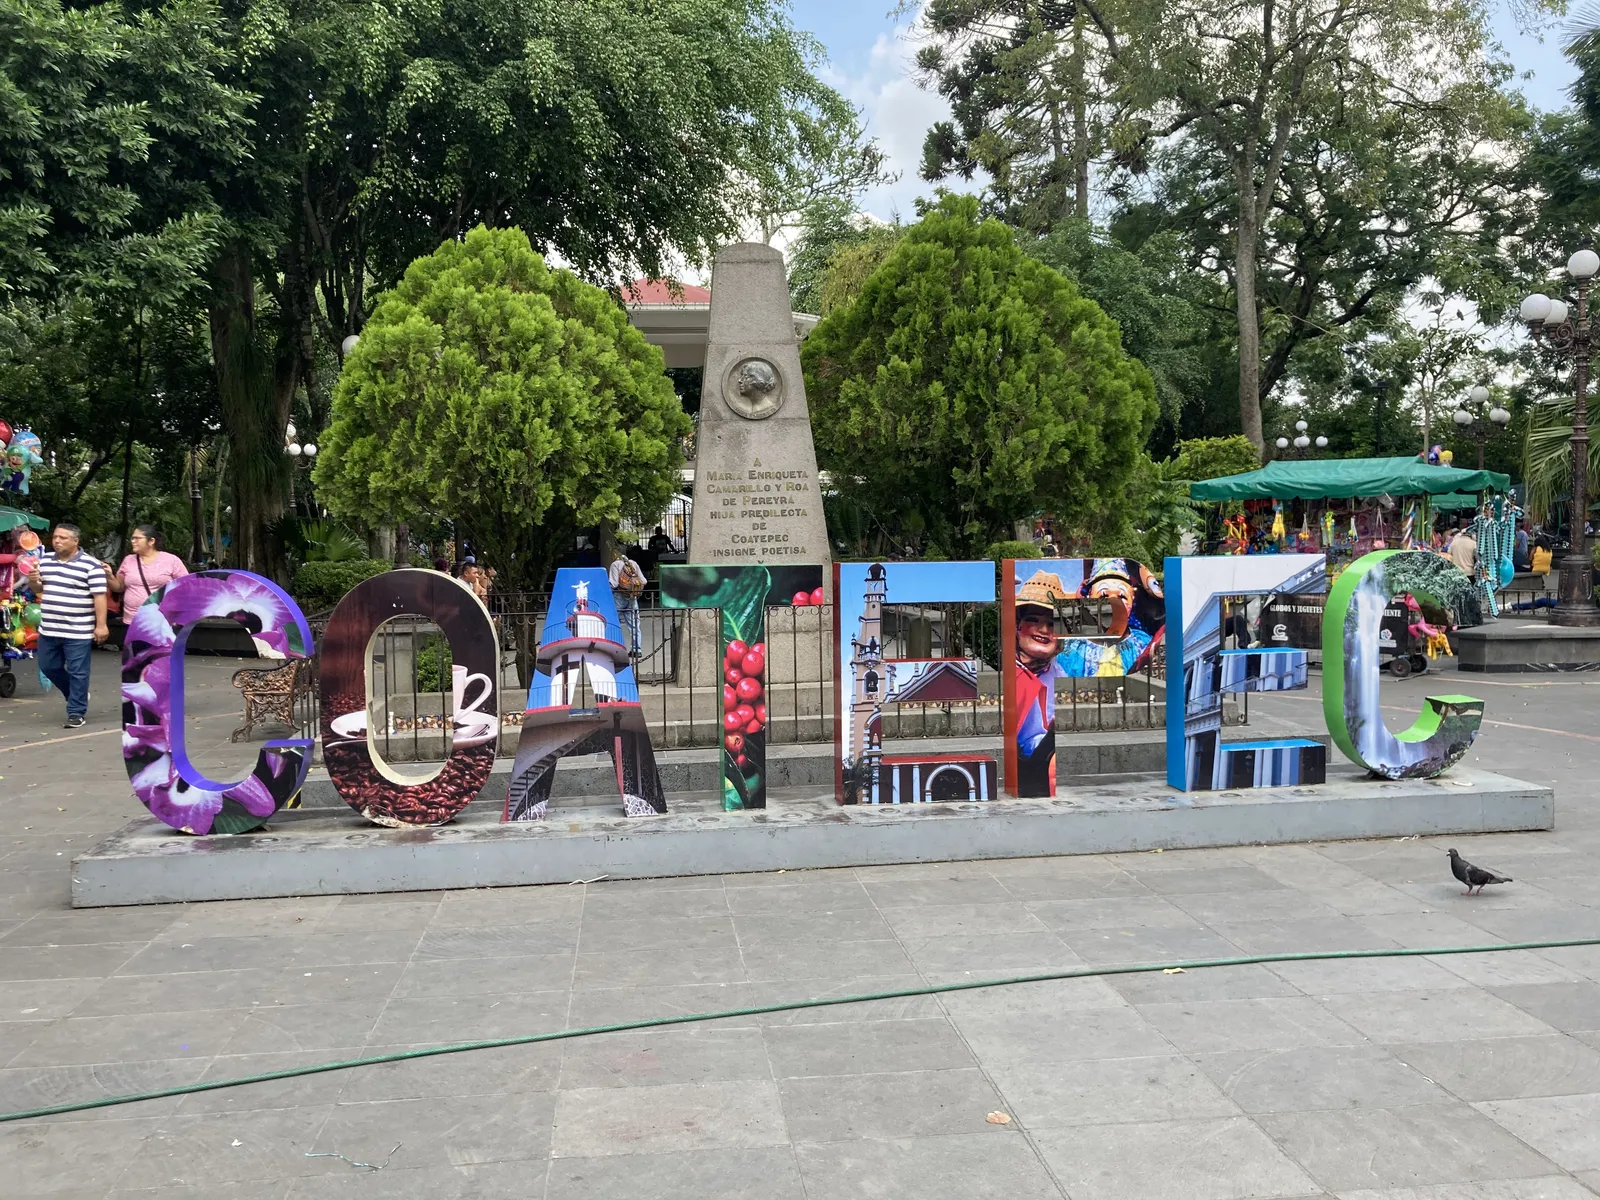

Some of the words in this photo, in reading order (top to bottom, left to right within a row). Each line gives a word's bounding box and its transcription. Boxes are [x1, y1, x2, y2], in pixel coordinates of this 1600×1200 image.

[753, 457, 762, 467] A
[748, 470, 809, 481] ENRIQUETA
[706, 484, 771, 494] CAMARILLO
[775, 484, 782, 492] Y
[785, 482, 809, 492] ROA
[722, 498, 736, 506] DE
[742, 495, 795, 506] PEREYRA
[710, 511, 736, 520] HIJA
[741, 508, 807, 519] PREDILECTA
[752, 522, 767, 531] DE
[731, 534, 789, 544] COATEPEC
[713, 547, 756, 557] INSIGNE
[761, 546, 807, 556] POETISA
[1269, 604, 1291, 613] GLOBOS
[1292, 605, 1297, 613] Y
[1297, 605, 1323, 614] JUGUETES
[121, 549, 1484, 836] COATEPEC
